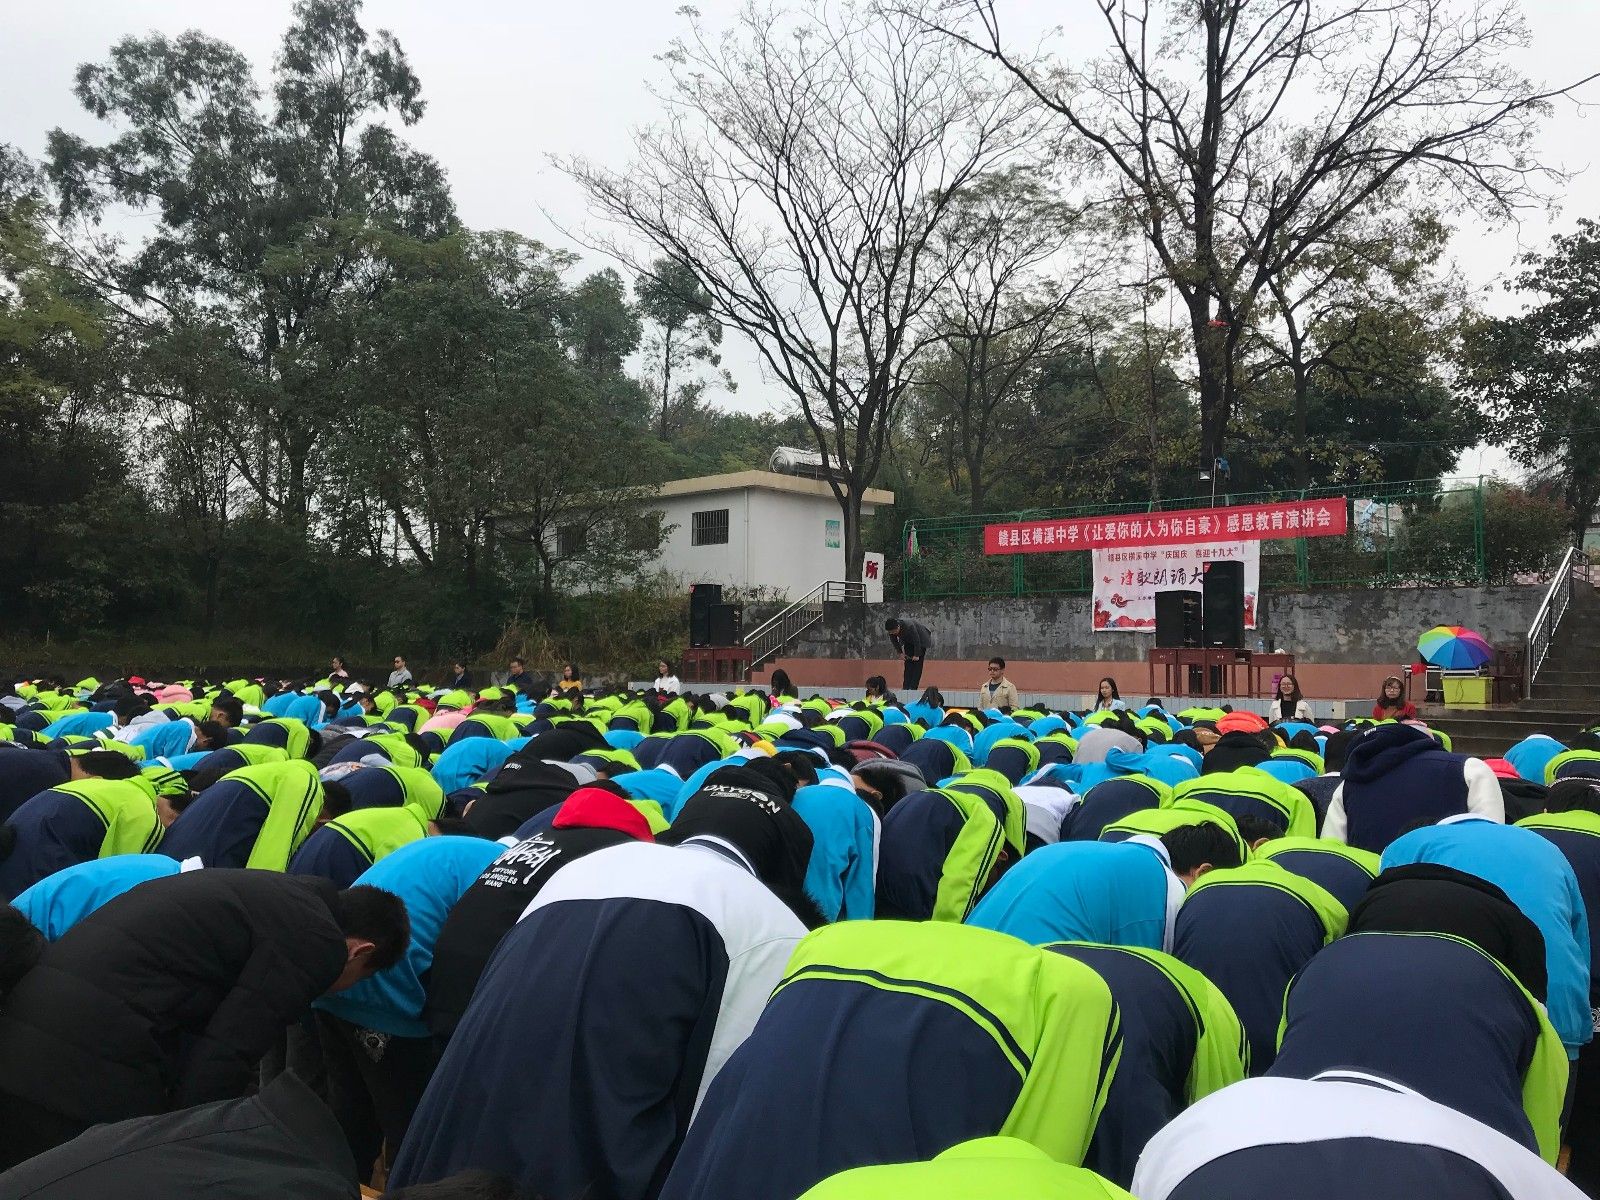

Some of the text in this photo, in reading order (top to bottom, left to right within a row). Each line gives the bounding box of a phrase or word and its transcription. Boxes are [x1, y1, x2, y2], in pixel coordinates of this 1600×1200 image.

[1120, 566, 1204, 587] 诗歌朗诵大
